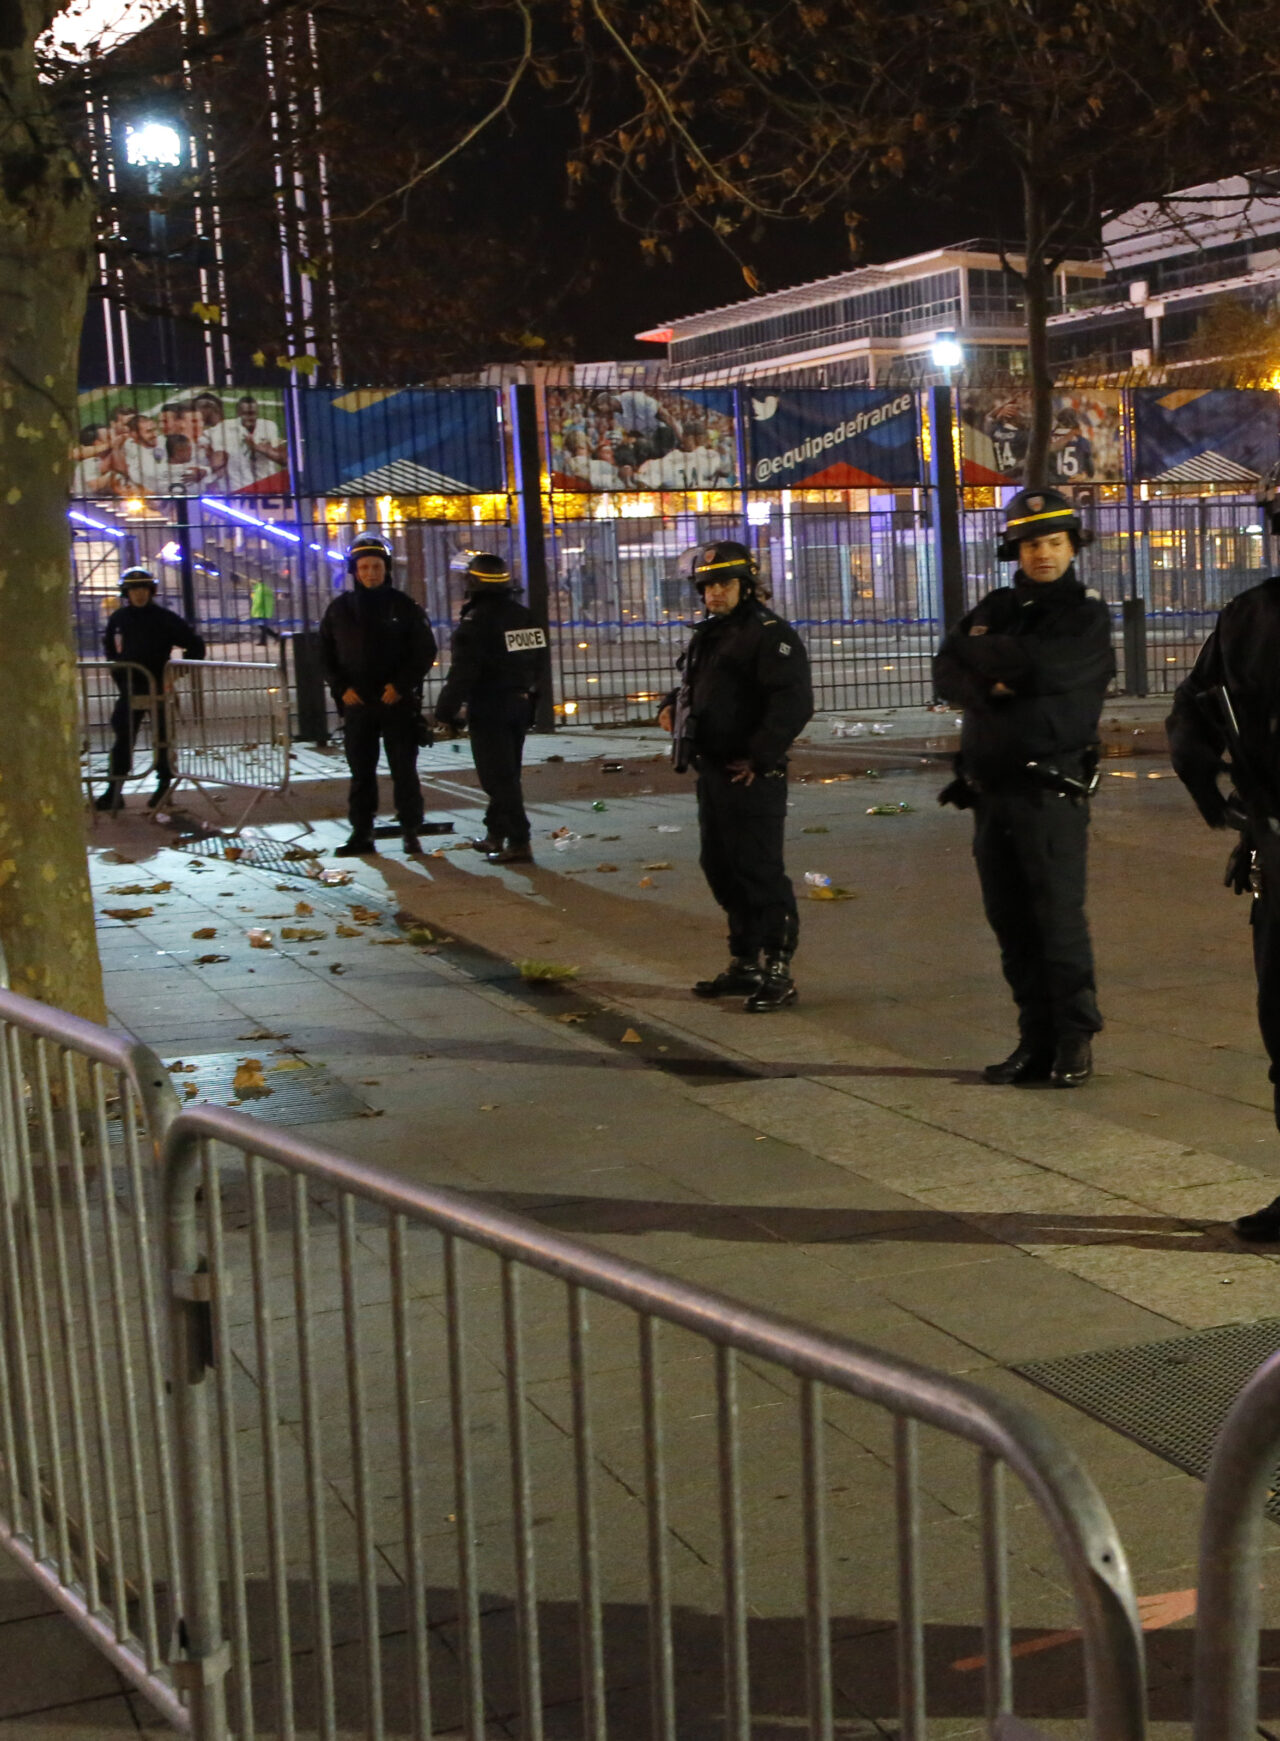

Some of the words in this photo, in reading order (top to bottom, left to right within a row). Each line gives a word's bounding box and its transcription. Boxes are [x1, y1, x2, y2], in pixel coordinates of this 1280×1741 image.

[755, 393, 912, 483] @equipedefrance
[1056, 446, 1079, 476] 15
[507, 631, 543, 648] POLICE
